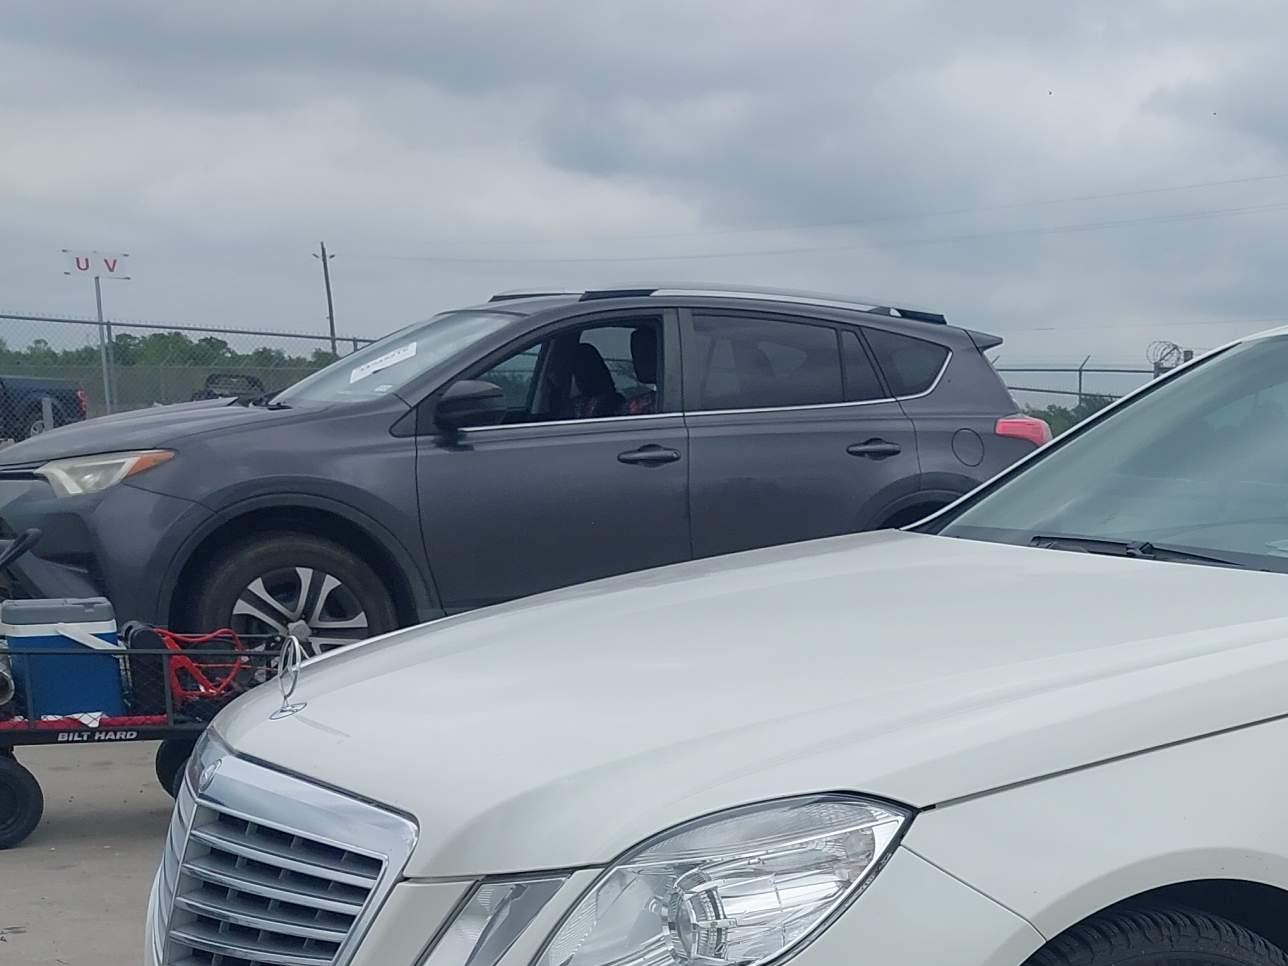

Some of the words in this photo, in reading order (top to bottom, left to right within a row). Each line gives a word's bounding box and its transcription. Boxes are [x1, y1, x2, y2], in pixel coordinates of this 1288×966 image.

[75, 256, 90, 272] U
[103, 258, 118, 273] V
[57, 731, 91, 742] BILT
[94, 730, 138, 741] HARD
